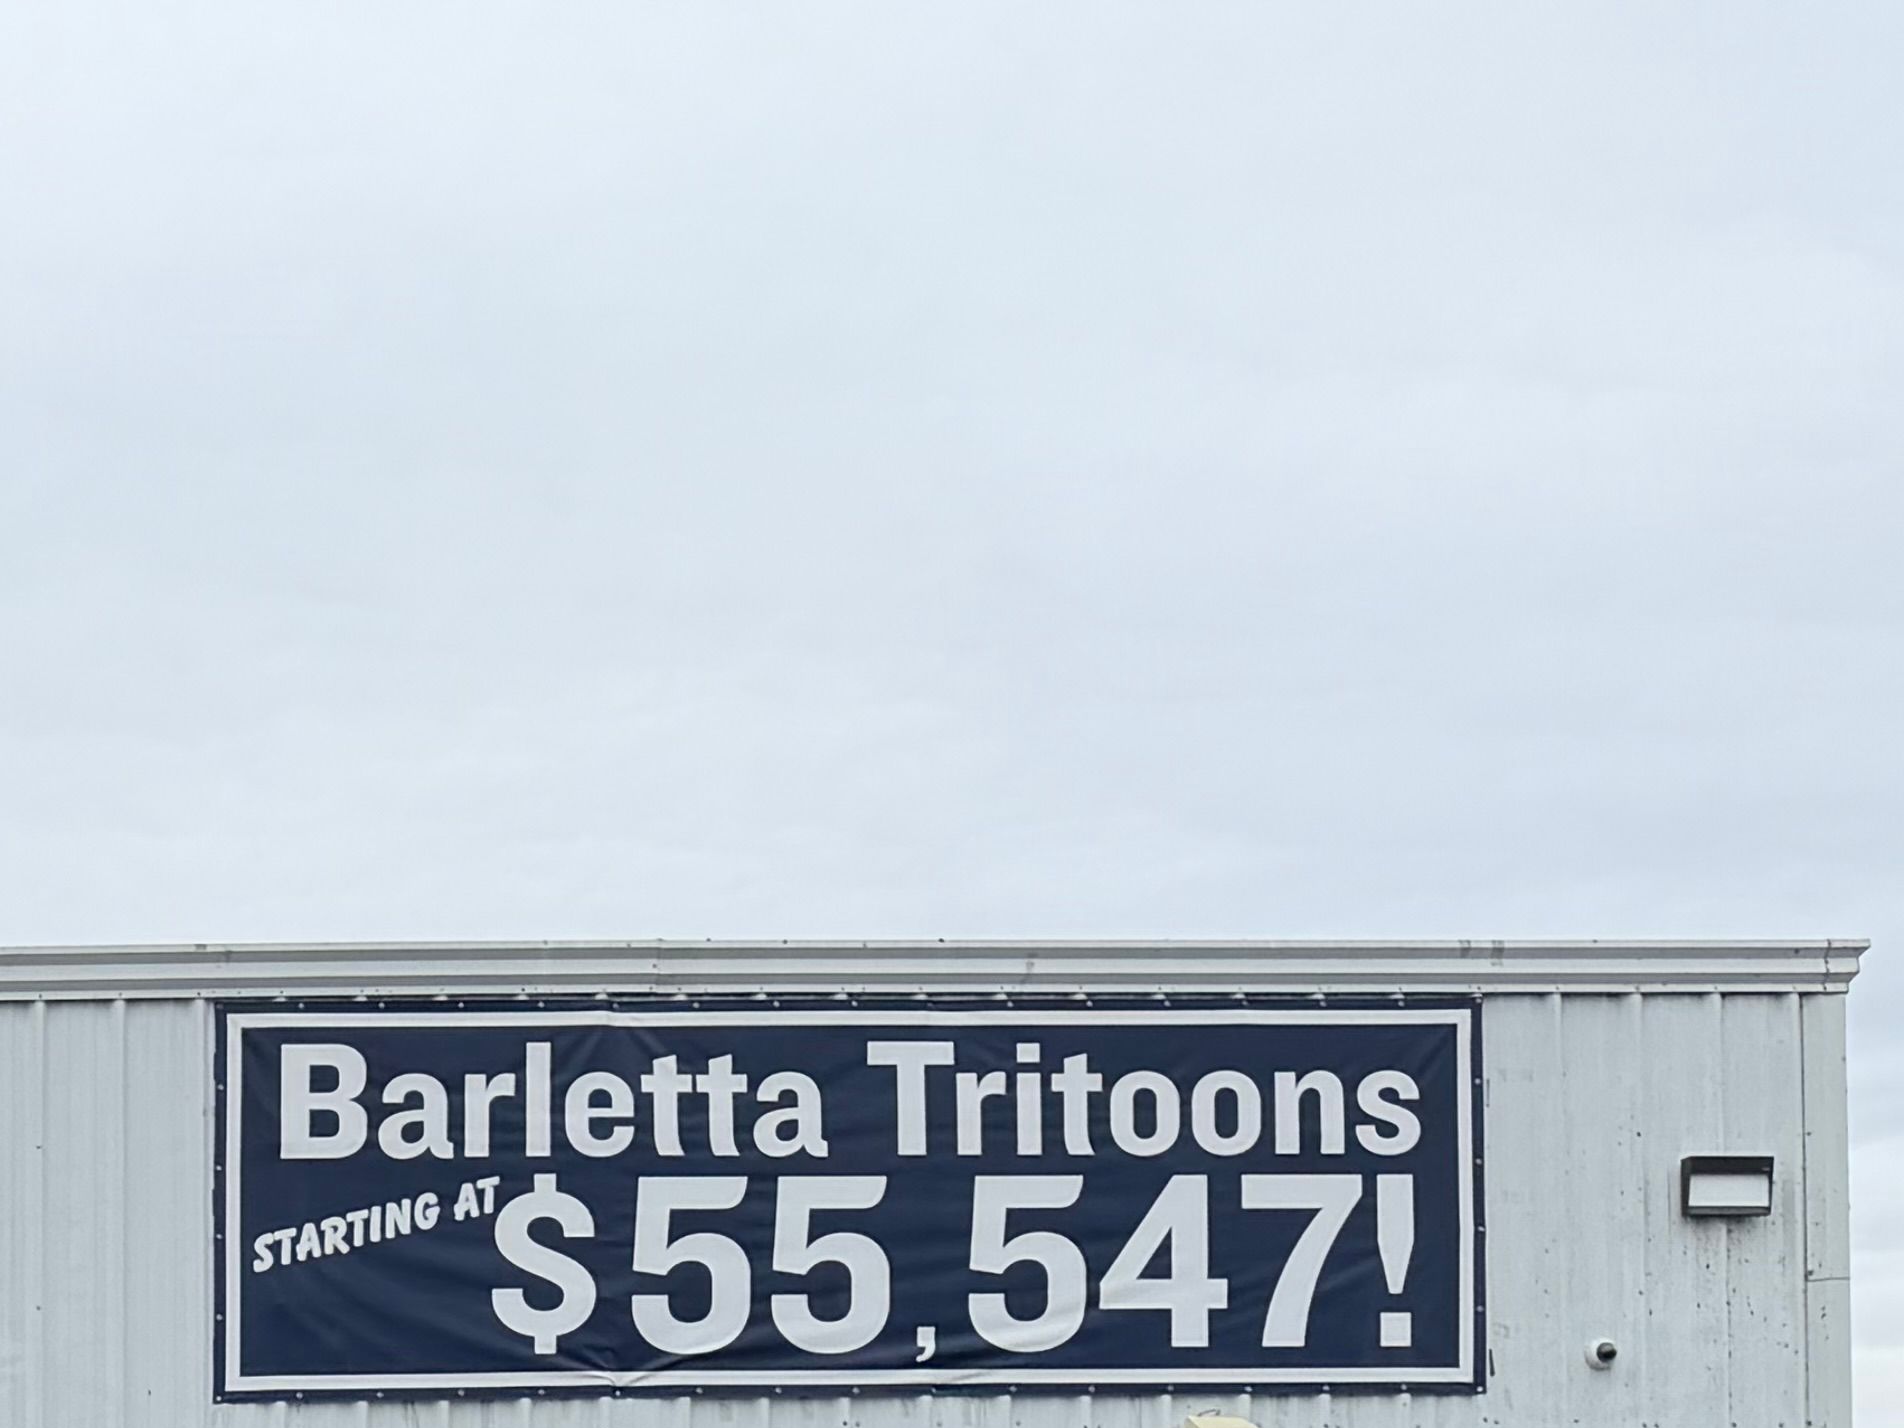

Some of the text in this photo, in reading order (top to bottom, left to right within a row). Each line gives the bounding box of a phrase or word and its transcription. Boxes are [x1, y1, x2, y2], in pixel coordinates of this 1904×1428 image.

[280, 1041, 1422, 1160] Barletta Tritoons
[253, 1176, 500, 1273] STARTING AT
[491, 1173, 1415, 1363] $55,547!
